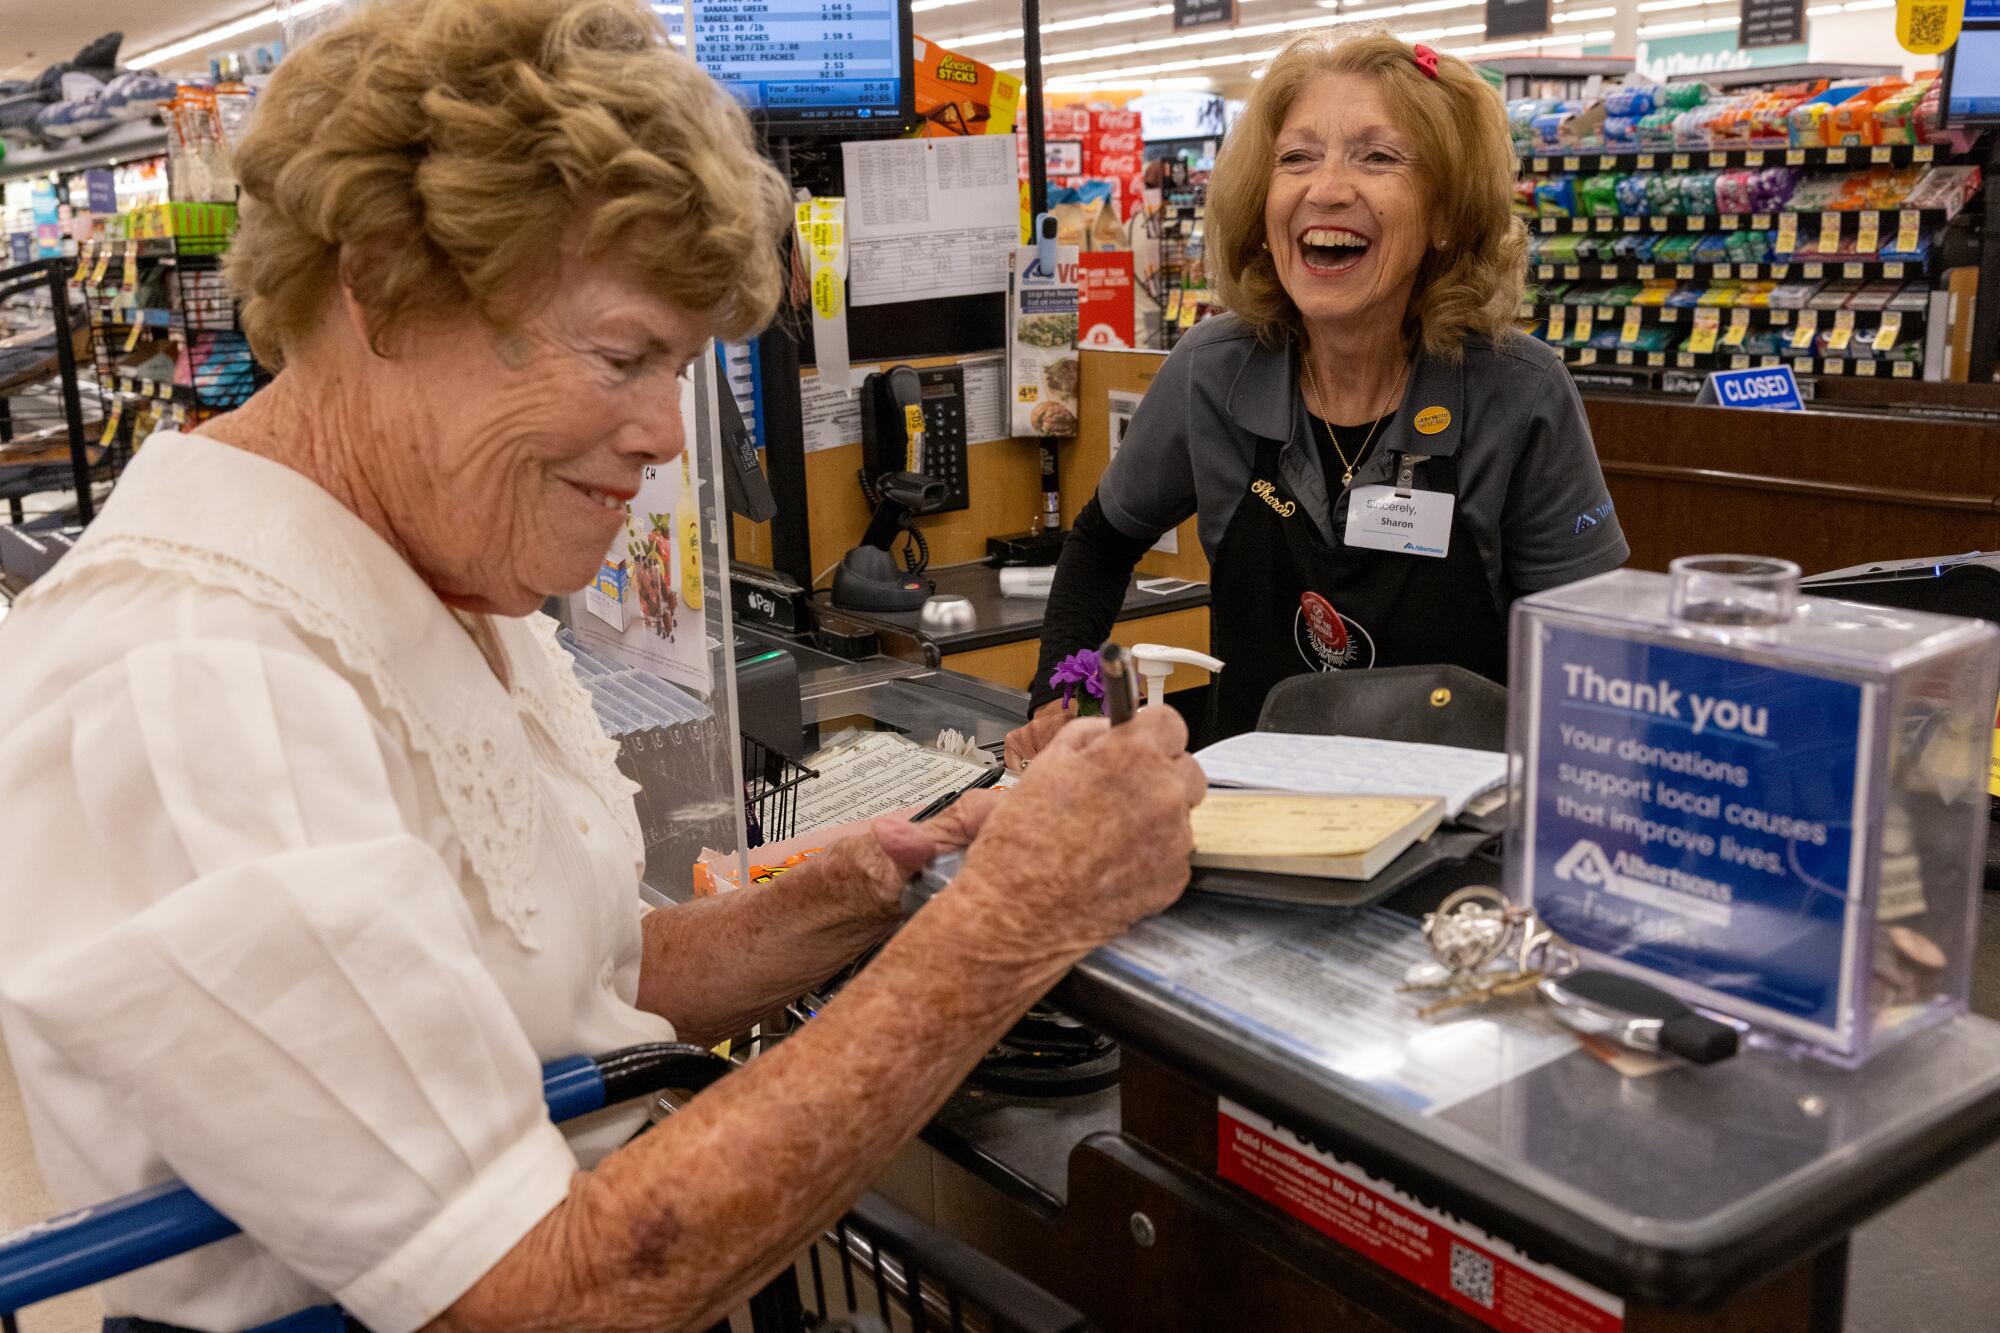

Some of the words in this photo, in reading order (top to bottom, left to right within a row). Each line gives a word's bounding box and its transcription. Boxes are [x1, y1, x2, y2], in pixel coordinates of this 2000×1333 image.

[703, 5, 738, 13] BANANAS
[703, 14, 729, 22] BAGEL
[733, 14, 754, 22] BULK
[720, 24, 744, 32] $3.49
[735, 34, 770, 42] PEACHES
[707, 64, 722, 72] TAX
[824, 62, 844, 70] 2.53
[760, 53, 795, 61] PEACHES
[769, 84, 789, 93] Your
[794, 83, 834, 95] Savings:
[1723, 374, 1789, 402] CLOSED
[911, 409, 921, 430] SDS
[1381, 517, 1414, 529] Sharon
[757, 593, 776, 618] Pay
[1562, 663, 1681, 718] Thank
[1690, 697, 1769, 738] you
[1558, 724, 1613, 756] Your
[1617, 737, 1749, 789] donations
[1557, 759, 1651, 805] support
[1656, 781, 1721, 817] local
[1725, 801, 1828, 847] causes
[1557, 795, 1603, 824] that
[1610, 810, 1716, 858] improve
[1719, 832, 1787, 877] lives.
[1614, 849, 1733, 903] Albertsons
[1235, 1127, 1261, 1151] Valid
[1261, 1141, 1332, 1189] Identification
[1332, 1177, 1357, 1204] May
[1357, 1190, 1374, 1212] Be
[1375, 1199, 1430, 1240] Required
